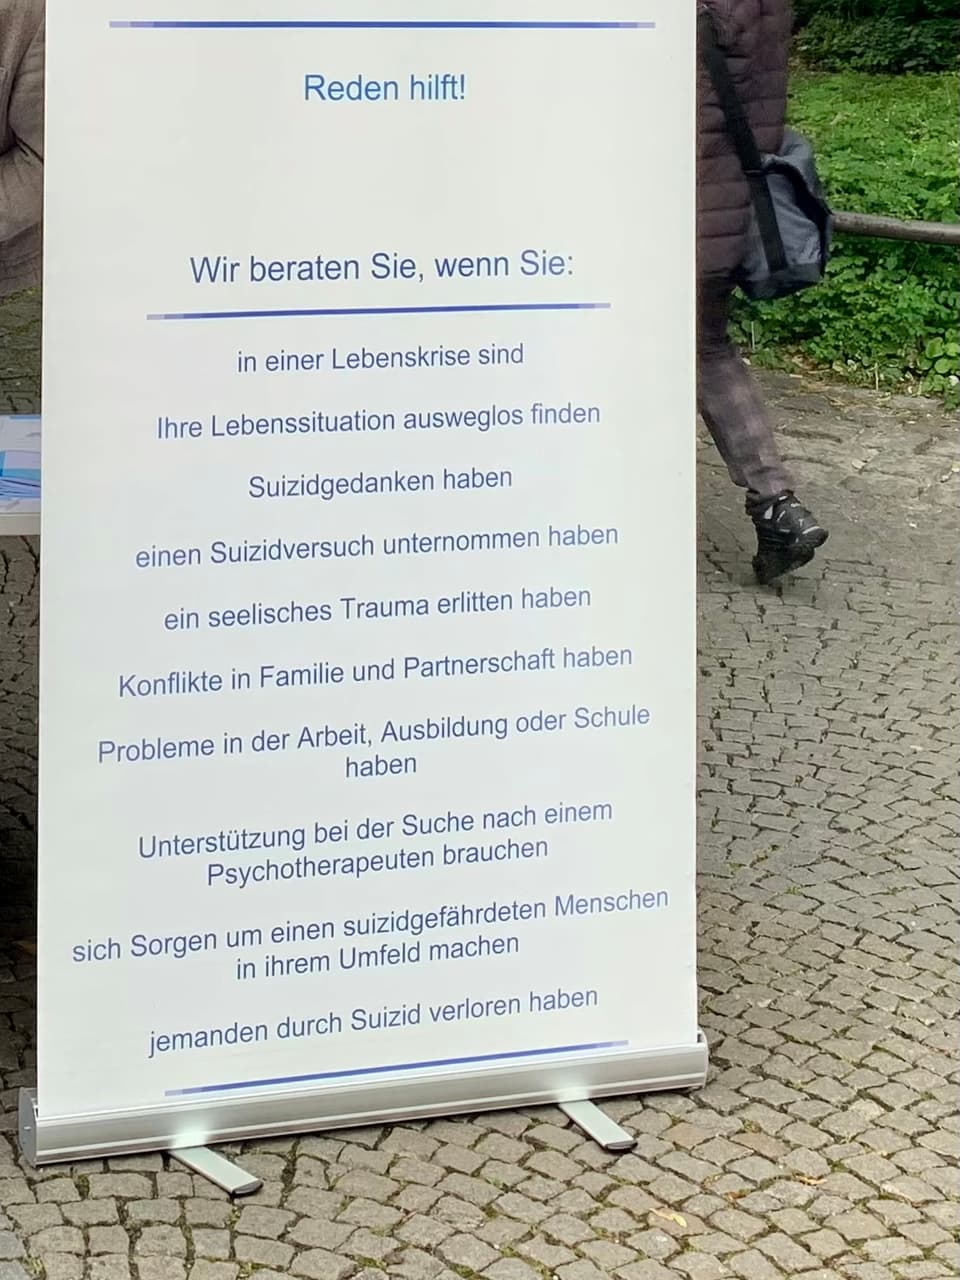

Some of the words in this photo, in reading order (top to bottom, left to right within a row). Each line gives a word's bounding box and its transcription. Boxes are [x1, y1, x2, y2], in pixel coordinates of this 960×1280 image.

[304, 73, 399, 102] Reden
[410, 73, 465, 101] hilft!
[189, 255, 241, 284] Wir
[250, 255, 360, 283] beraten
[370, 251, 424, 284] Sie,
[433, 255, 510, 278] wenn
[519, 249, 573, 276] Sie:
[237, 350, 257, 373] in
[264, 348, 326, 372] einer
[331, 344, 471, 370] Lebenskrise
[477, 342, 524, 366] sind
[157, 416, 203, 440] Ihre
[211, 408, 396, 437] Lebenssituation
[403, 404, 524, 433] ausweglos
[529, 401, 600, 425] finden
[248, 469, 435, 501] Suizidgedanken
[443, 466, 513, 490] haben
[135, 544, 202, 569] einen
[210, 533, 375, 564] Suizidversuch
[383, 530, 540, 556] unternommen
[548, 523, 618, 547] haben
[164, 607, 200, 631] ein
[208, 600, 333, 628] seelisches
[339, 597, 430, 620] Trauma
[437, 590, 513, 615] erlitten
[521, 586, 591, 609] haben
[119, 670, 223, 698] Konflikte
[231, 667, 251, 691] in
[260, 661, 345, 689] Familie
[352, 657, 395, 682] und
[404, 647, 556, 679] Partnerschaft
[563, 645, 632, 669] haben
[98, 736, 215, 764] Probleme
[223, 731, 243, 755] in
[251, 729, 291, 753] der
[296, 722, 373, 750] Arbeit,
[380, 715, 508, 744] Ausbildung
[515, 709, 568, 733] oder
[573, 704, 650, 729] Schule
[345, 753, 417, 779] haben
[139, 828, 306, 859] Unterstützung
[314, 819, 349, 845] bei
[356, 817, 396, 841] der
[401, 810, 475, 837] Suche
[482, 804, 537, 830] nach
[544, 801, 613, 825] einem
[206, 848, 436, 889] Psychotherapeuten
[443, 837, 548, 866] brauchen
[72, 936, 121, 963] sich
[130, 932, 217, 959] Sorgen
[226, 928, 263, 949] um
[270, 920, 335, 944] einen
[342, 900, 547, 938] suizidgefährdeten
[554, 888, 669, 917] Menschen
[236, 957, 256, 981] in
[265, 954, 331, 978] ihrem
[339, 940, 421, 970] Umfeld
[429, 934, 519, 961] machen
[147, 1021, 268, 1059] jemanden
[276, 1011, 343, 1040] durch
[350, 1002, 421, 1031] Suizid
[428, 997, 521, 1023] verloren
[529, 987, 598, 1013] haben
